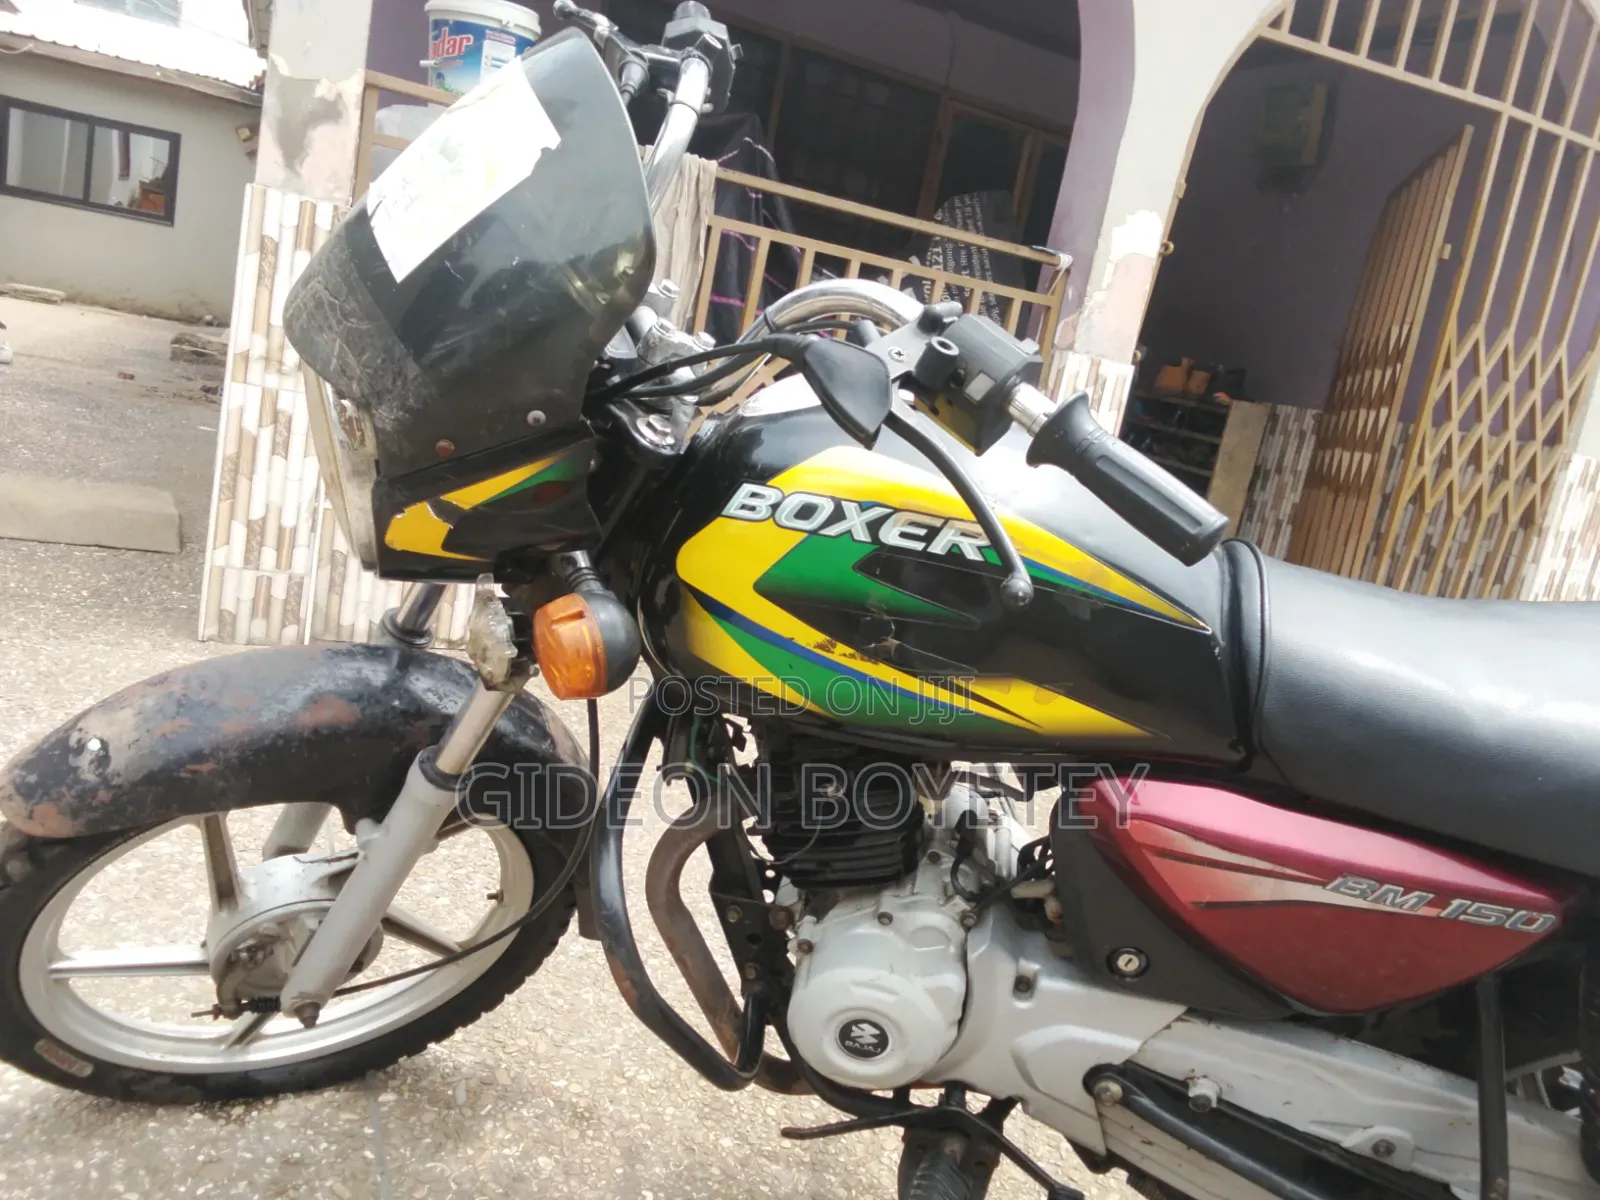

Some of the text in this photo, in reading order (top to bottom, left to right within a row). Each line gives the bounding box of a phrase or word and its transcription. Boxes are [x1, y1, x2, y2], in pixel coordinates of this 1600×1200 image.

[720, 482, 992, 562] BOXER
[1324, 872, 1556, 933] BM 150
[844, 1040, 881, 1053] BAJAJ
